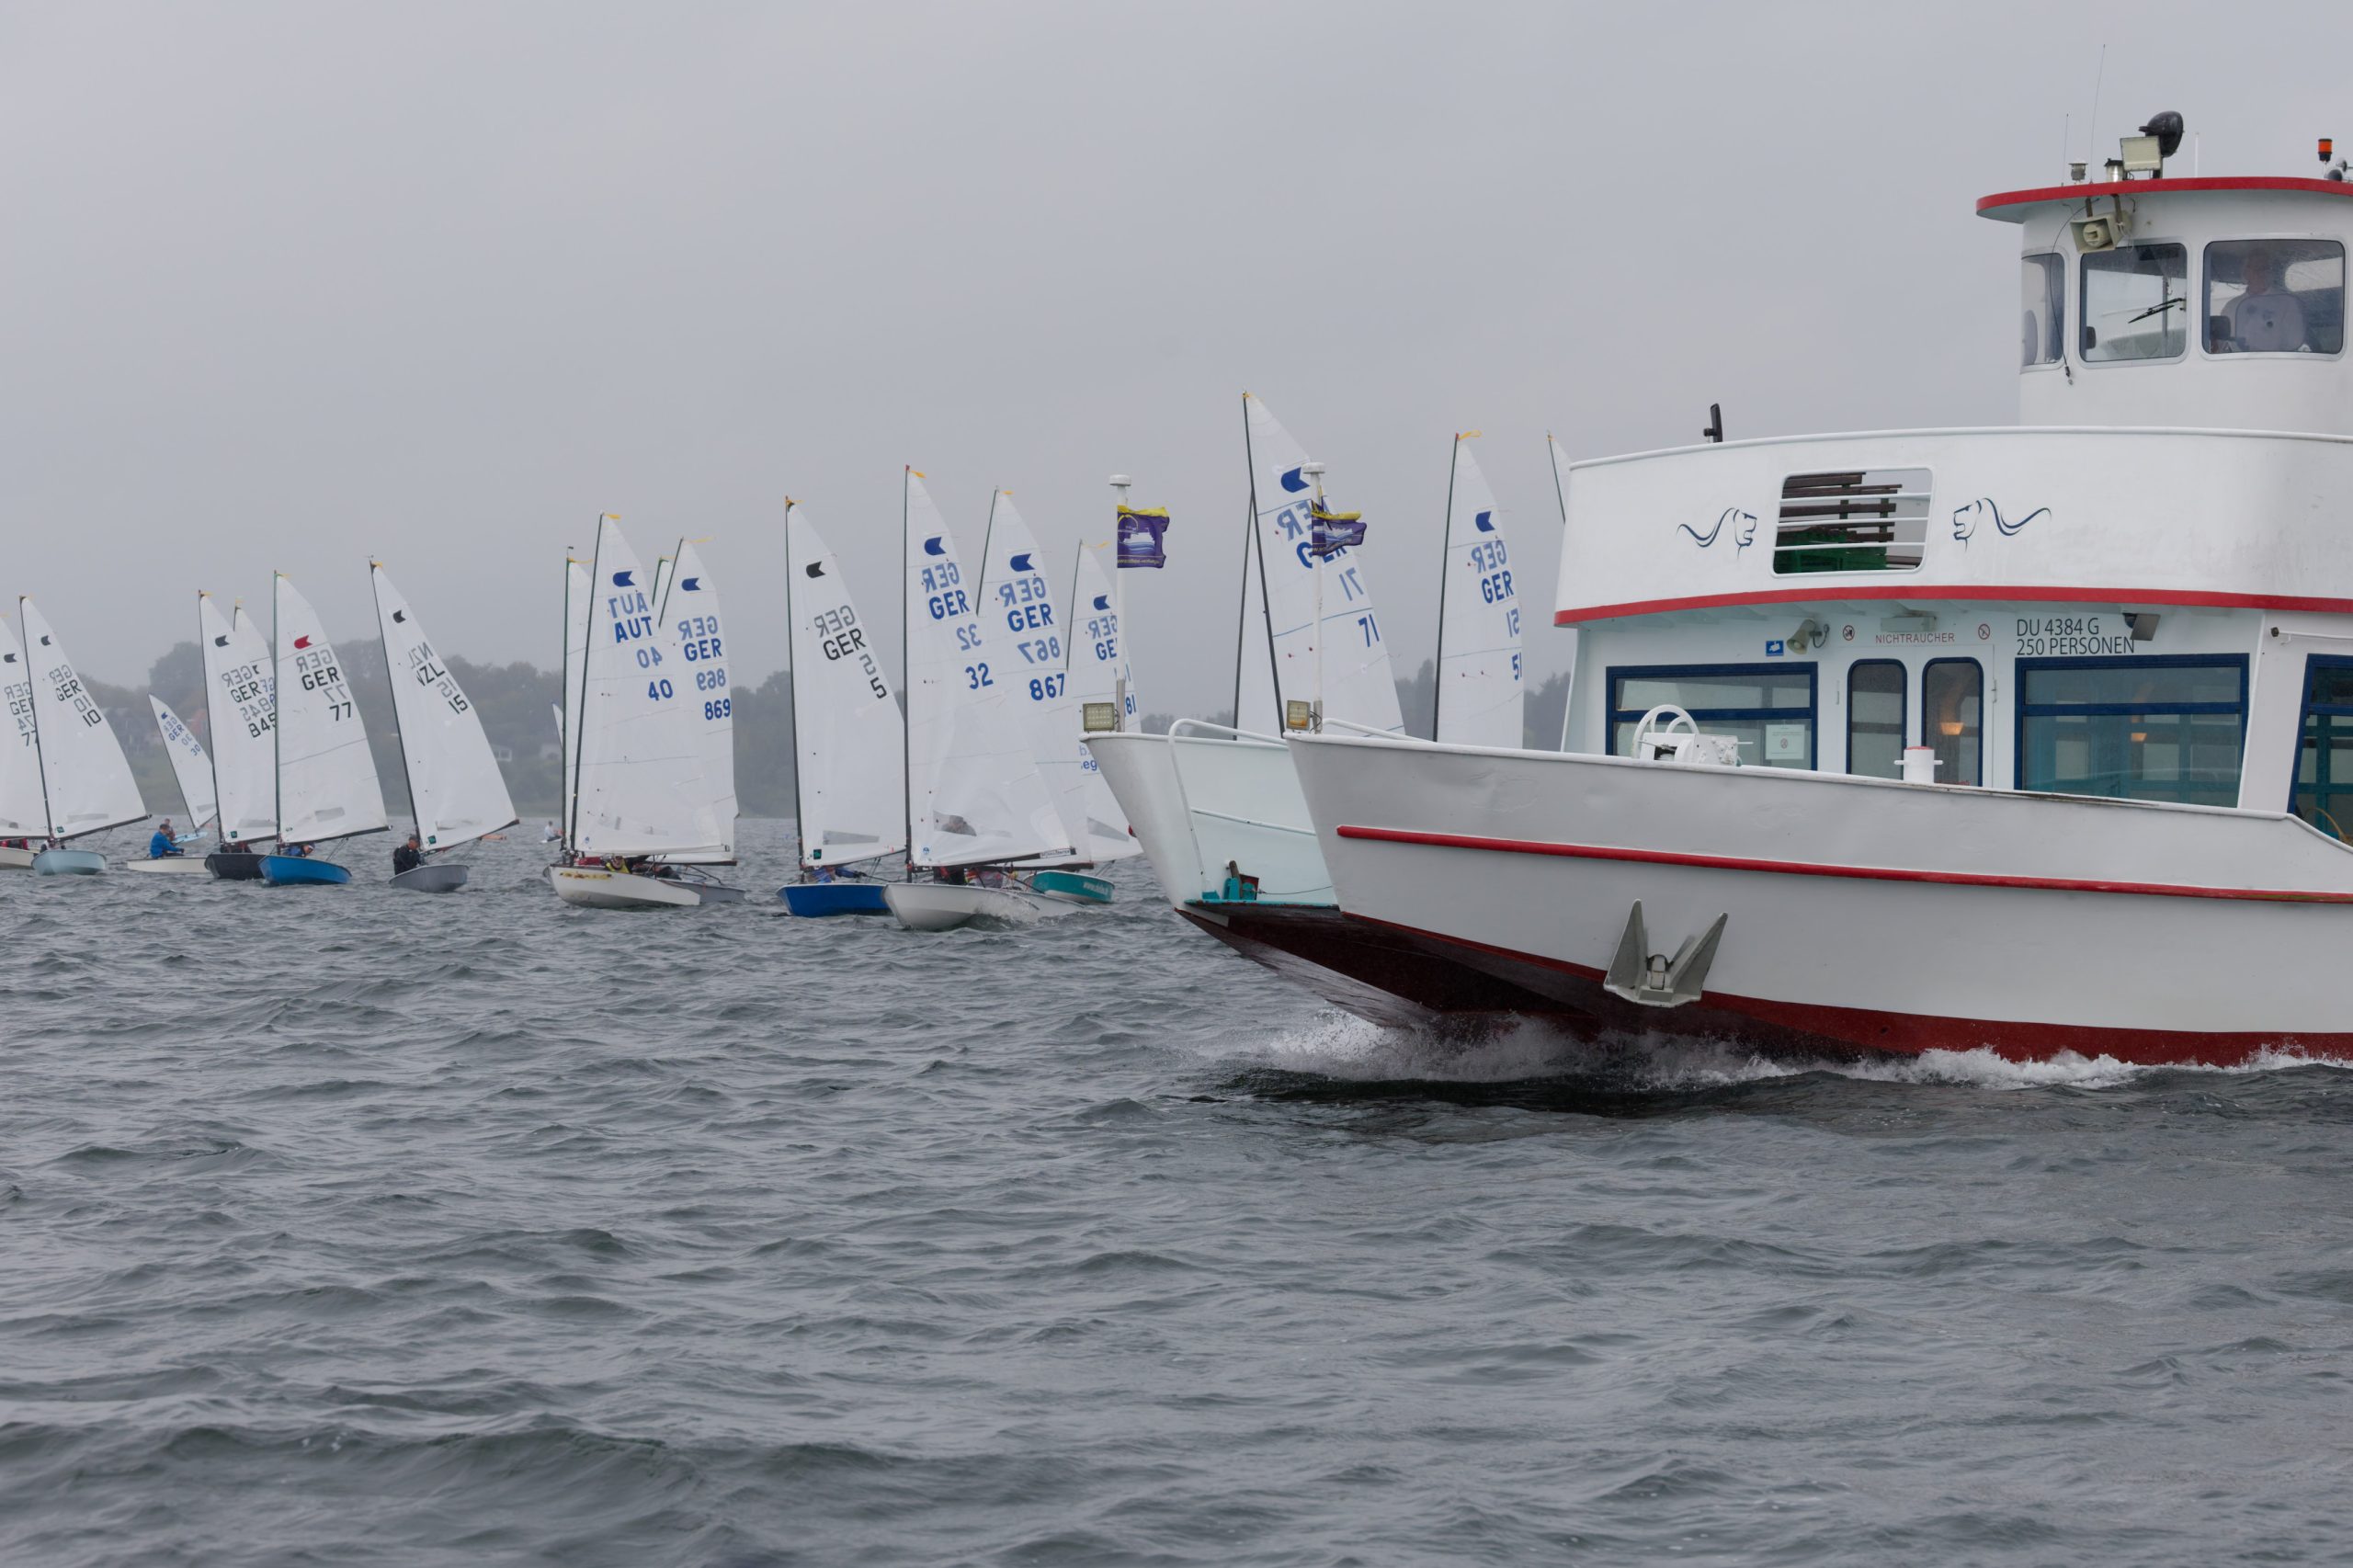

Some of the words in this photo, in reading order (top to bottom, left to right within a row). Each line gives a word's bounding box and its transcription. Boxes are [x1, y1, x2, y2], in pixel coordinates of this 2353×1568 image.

[1481, 570, 1514, 604] GER
[928, 589, 970, 619] GER
[614, 616, 653, 643] AUT
[1007, 603, 1053, 632] GER
[2017, 619, 2040, 637] DU
[2044, 618, 2083, 636] 4384
[2087, 617, 2099, 635] G
[1358, 613, 1380, 647] 71
[1875, 632, 1955, 644] NICHTRAUCHER
[684, 638, 722, 662] GER
[823, 628, 867, 661] GER
[1095, 638, 1118, 661] GE
[2017, 638, 2045, 655] 250
[2050, 636, 2135, 655] PERSONEN
[301, 666, 340, 691] GER
[416, 663, 446, 687] NZL
[965, 662, 994, 689] 32
[1512, 652, 1523, 681] 51
[56, 679, 82, 701] GER
[230, 681, 262, 703] GER
[648, 678, 673, 701] 40
[870, 676, 887, 699] 5
[1029, 673, 1065, 701] 867
[329, 701, 351, 722] 77
[449, 694, 468, 714] 15
[704, 699, 732, 721] 869
[1124, 694, 1136, 718] 81
[82, 709, 102, 727] 10
[248, 712, 277, 738] 845
[168, 724, 184, 741] GER
